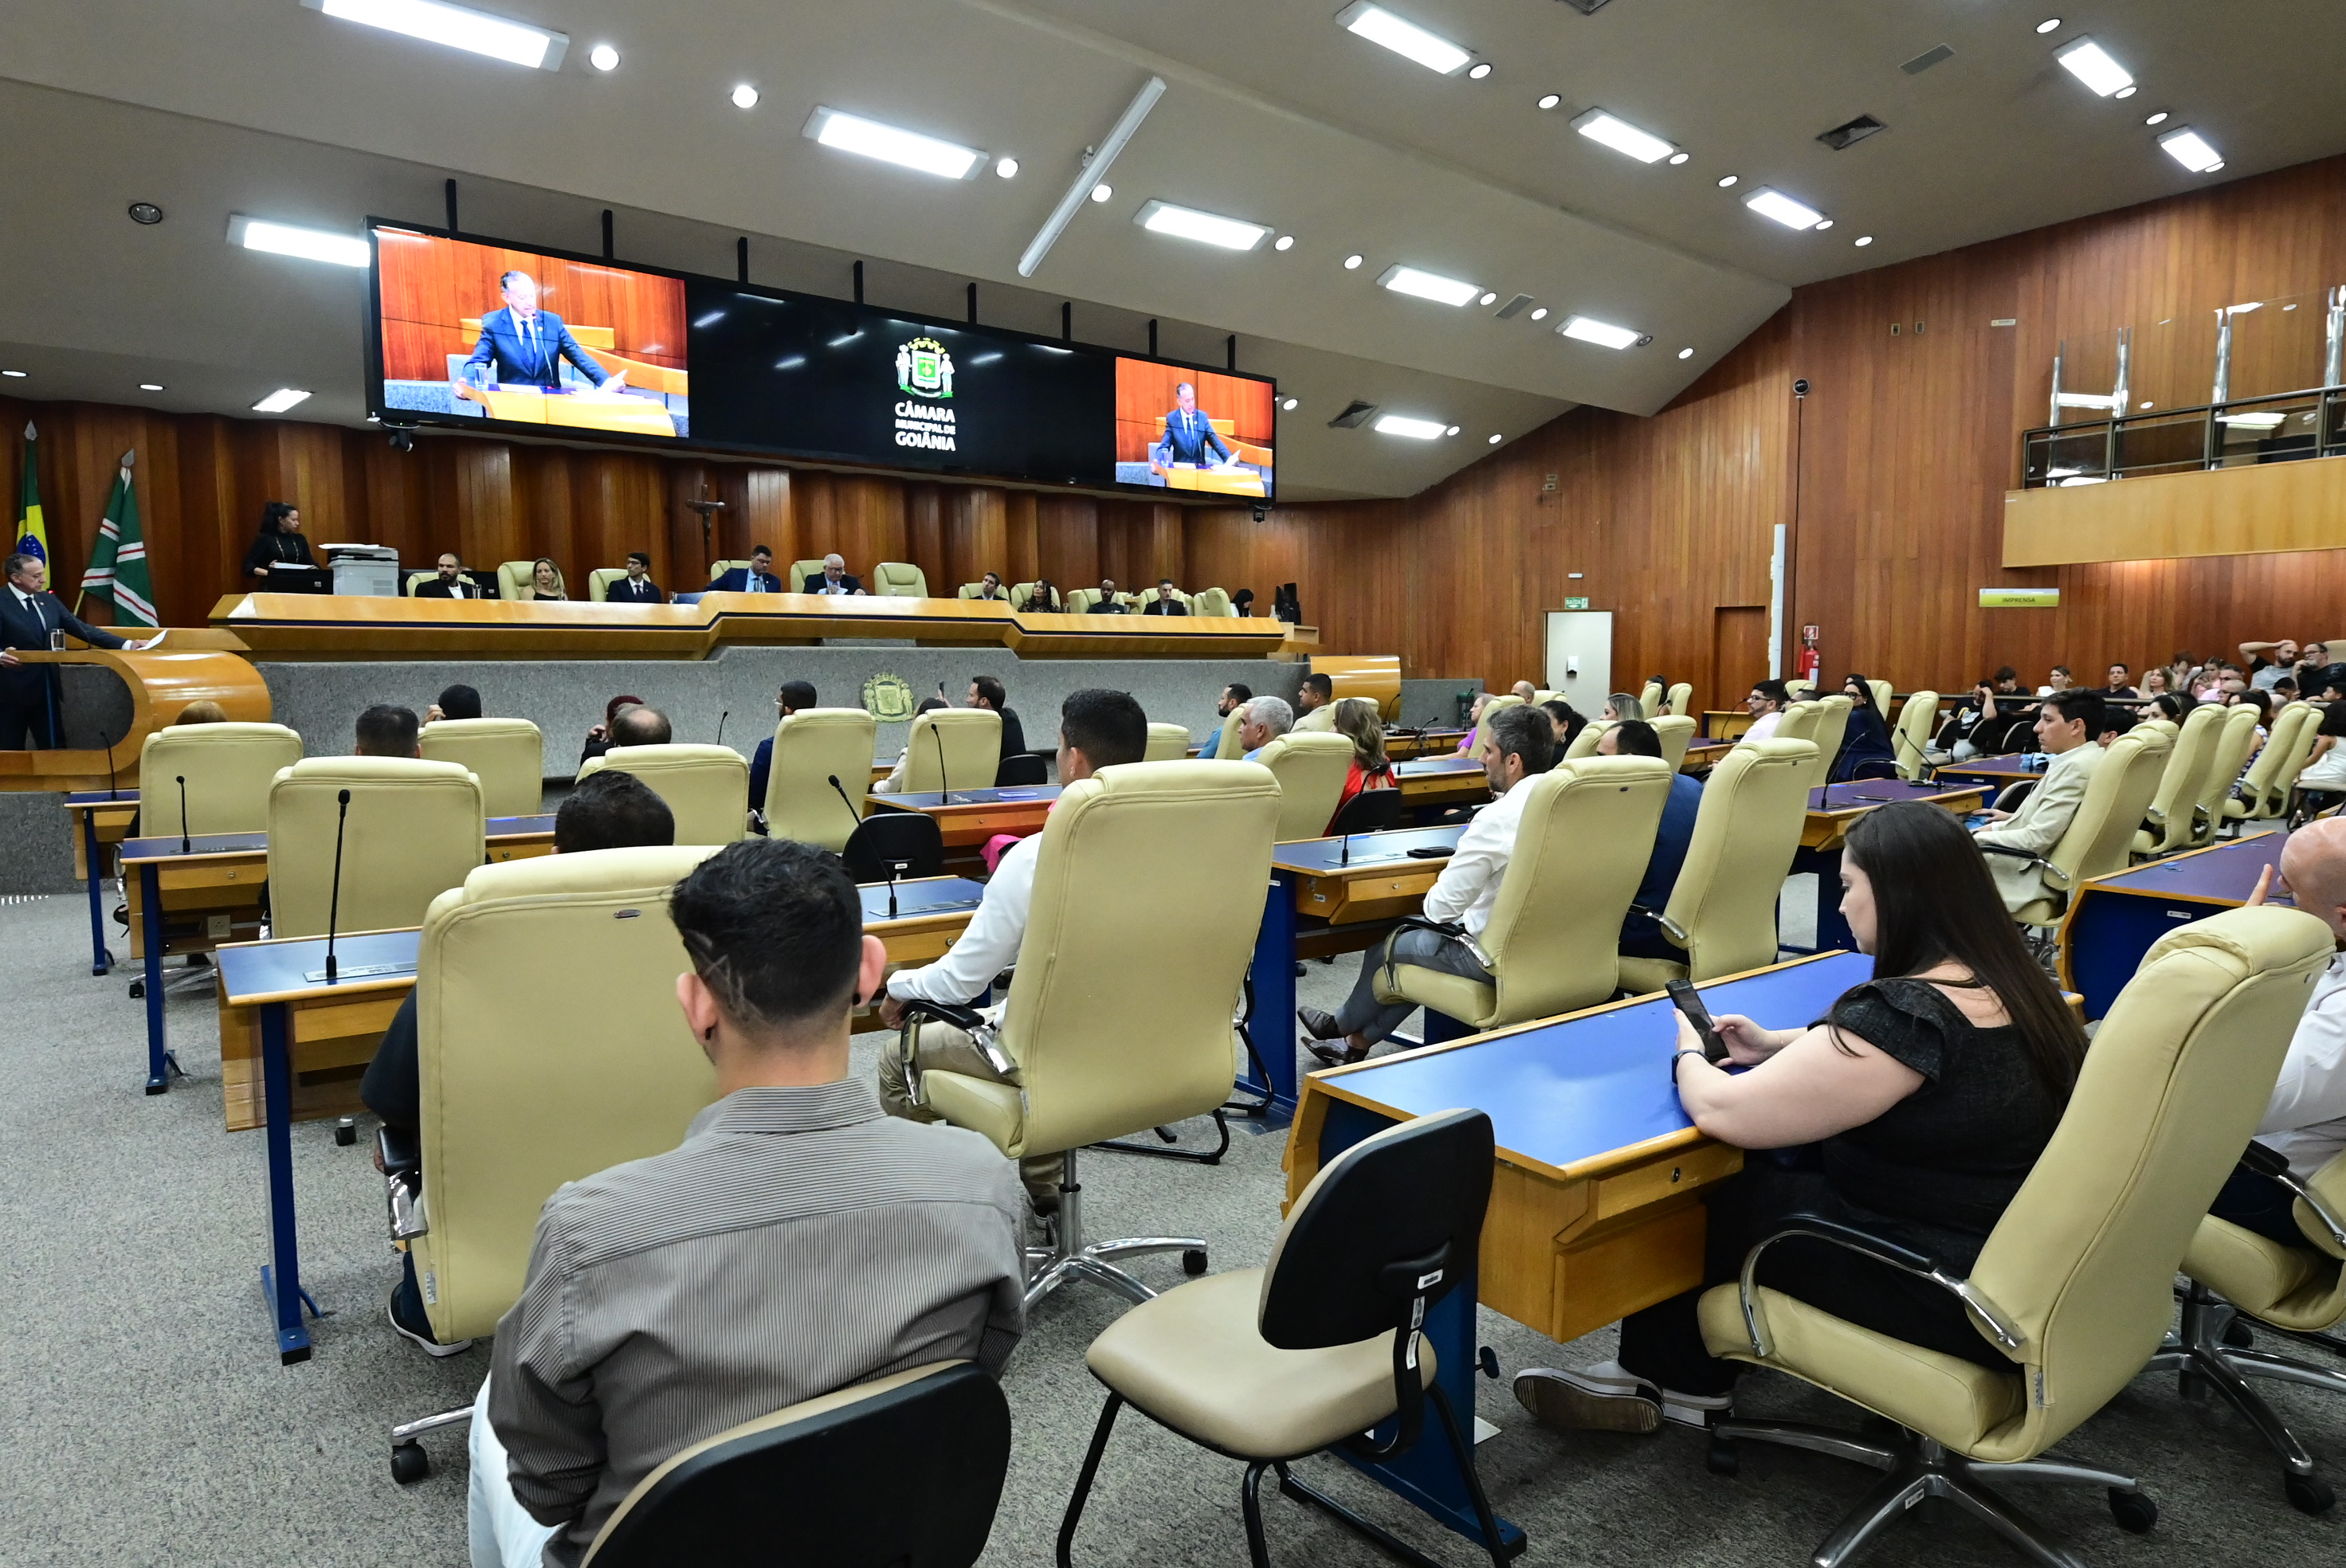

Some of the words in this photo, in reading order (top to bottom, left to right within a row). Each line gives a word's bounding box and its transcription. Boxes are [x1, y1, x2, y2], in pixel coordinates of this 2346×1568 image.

[895, 400, 955, 422] CÂMARA
[895, 418, 944, 433] MUNICIPAL
[944, 425, 956, 435] DE
[895, 431, 956, 452] GOIÂNIA
